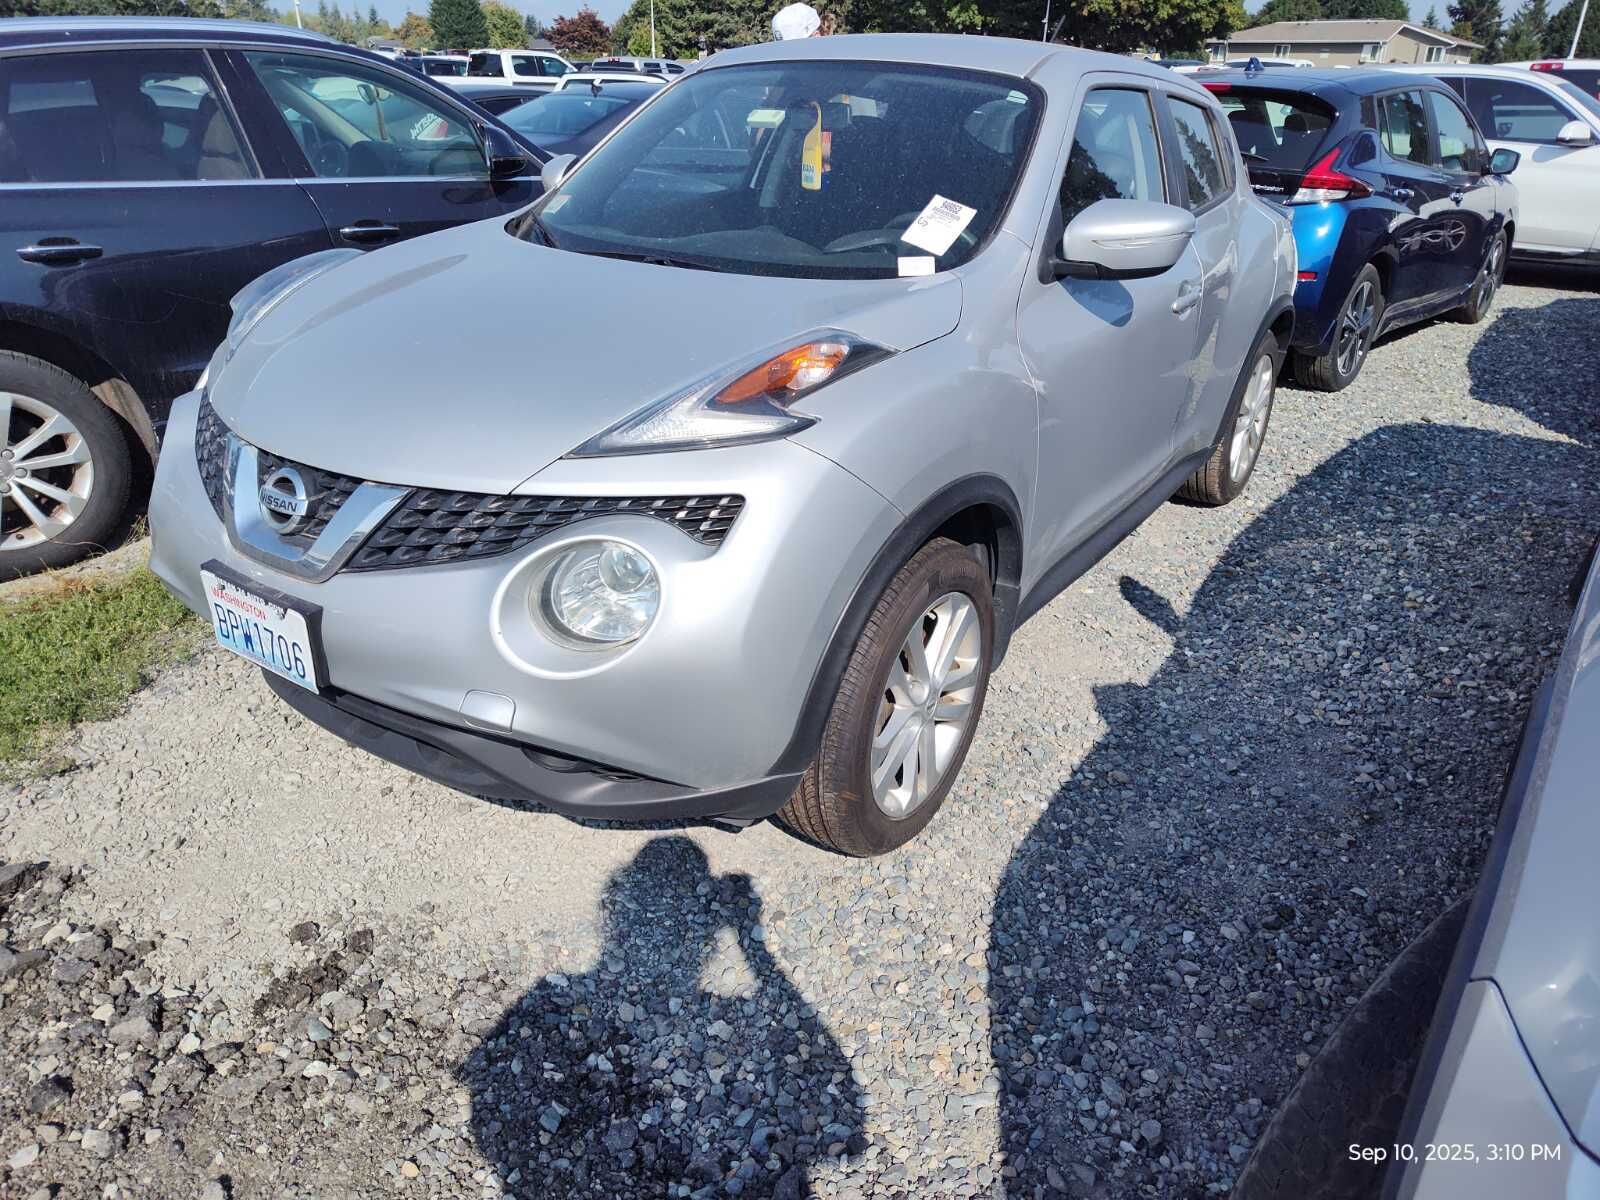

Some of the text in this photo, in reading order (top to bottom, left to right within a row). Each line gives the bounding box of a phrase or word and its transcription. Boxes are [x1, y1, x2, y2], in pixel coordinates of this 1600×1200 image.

[261, 492, 298, 513] NISSAN
[211, 585, 267, 621] WASHINGTON
[213, 602, 306, 679] BPW1706
